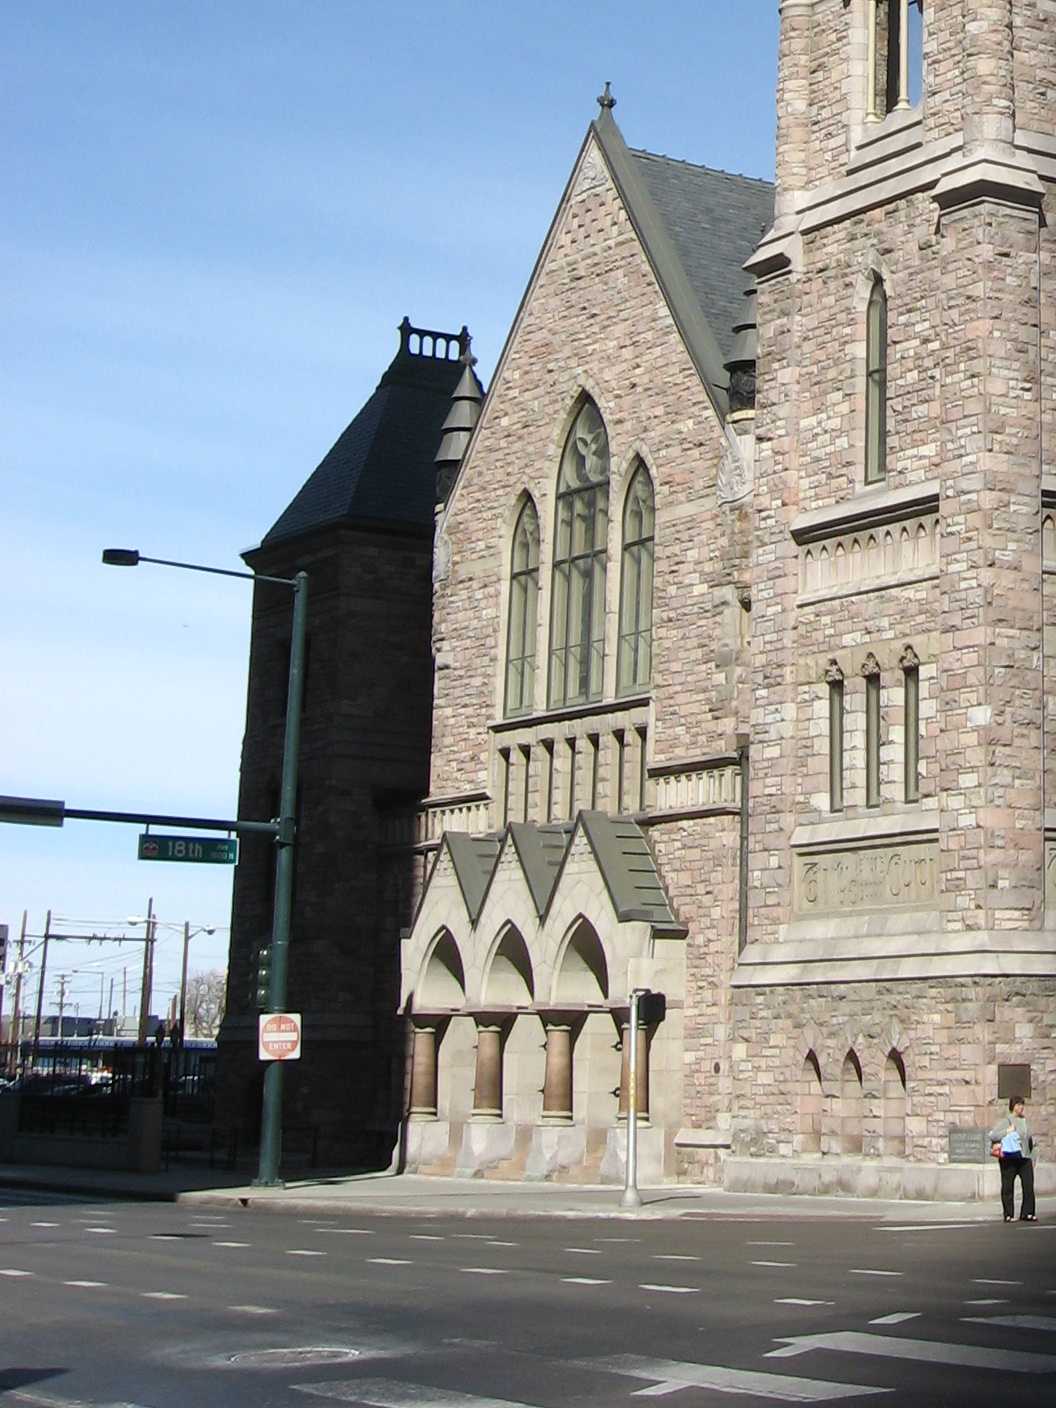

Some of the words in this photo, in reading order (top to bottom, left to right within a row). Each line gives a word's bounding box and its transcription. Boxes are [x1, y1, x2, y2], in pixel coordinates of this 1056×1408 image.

[167, 840, 203, 858] 18th
[266, 1023, 277, 1031] DO
[279, 1022, 295, 1031] NOT
[268, 1042, 292, 1051] ENTER
